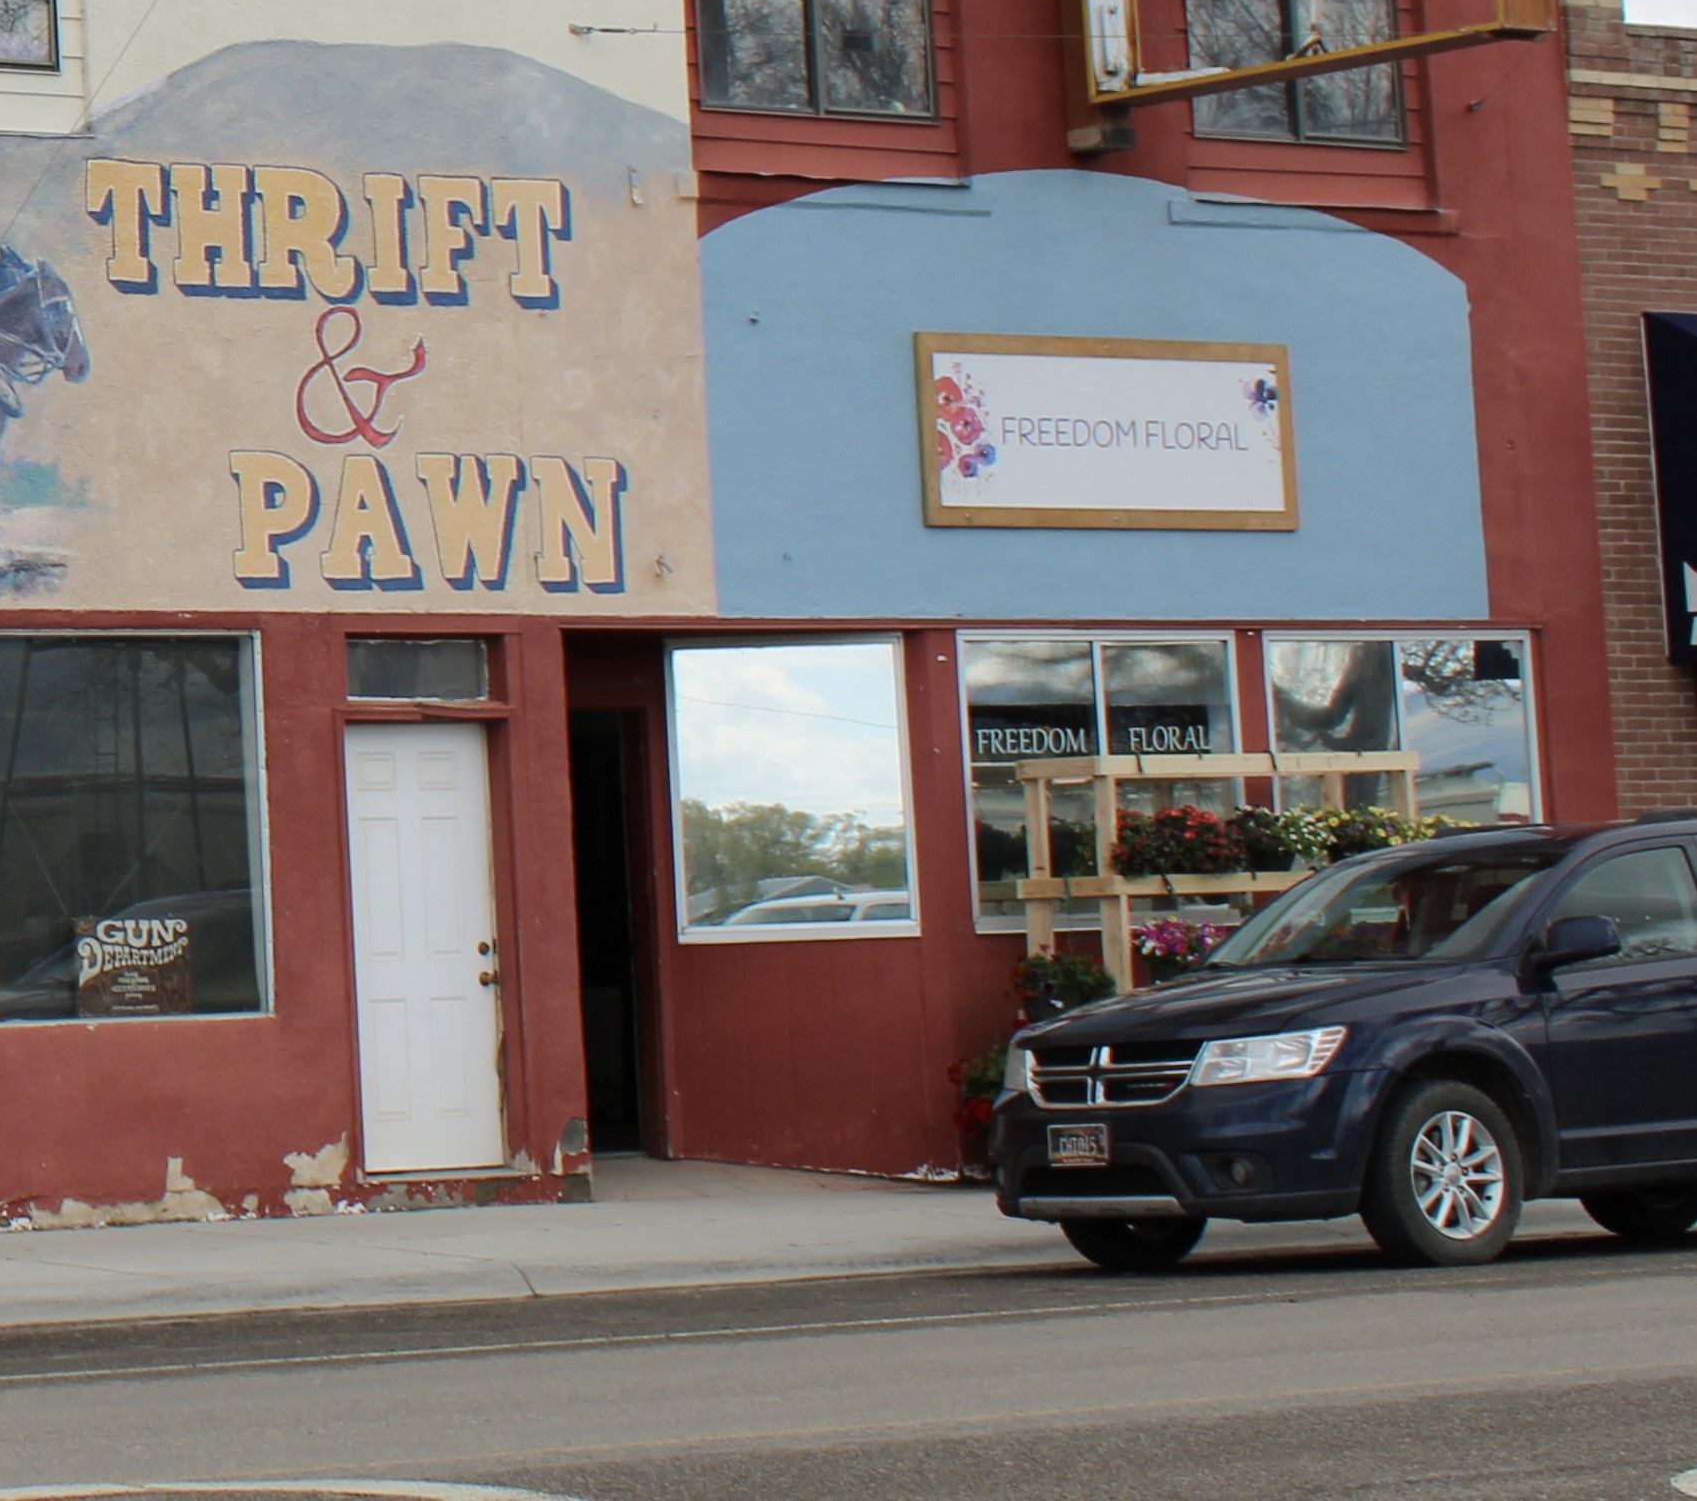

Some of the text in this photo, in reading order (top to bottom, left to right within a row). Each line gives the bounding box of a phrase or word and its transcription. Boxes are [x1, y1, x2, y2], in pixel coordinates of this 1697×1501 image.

[86, 157, 572, 310] THRIFT
[295, 305, 428, 448] &
[1002, 416, 1248, 452] FREEDOM FLORAL
[228, 450, 628, 594] PAWN
[976, 725, 1211, 754] FREEDOM FLORAL
[96, 919, 188, 948] GUN
[77, 936, 188, 987] DEPARTMENT
